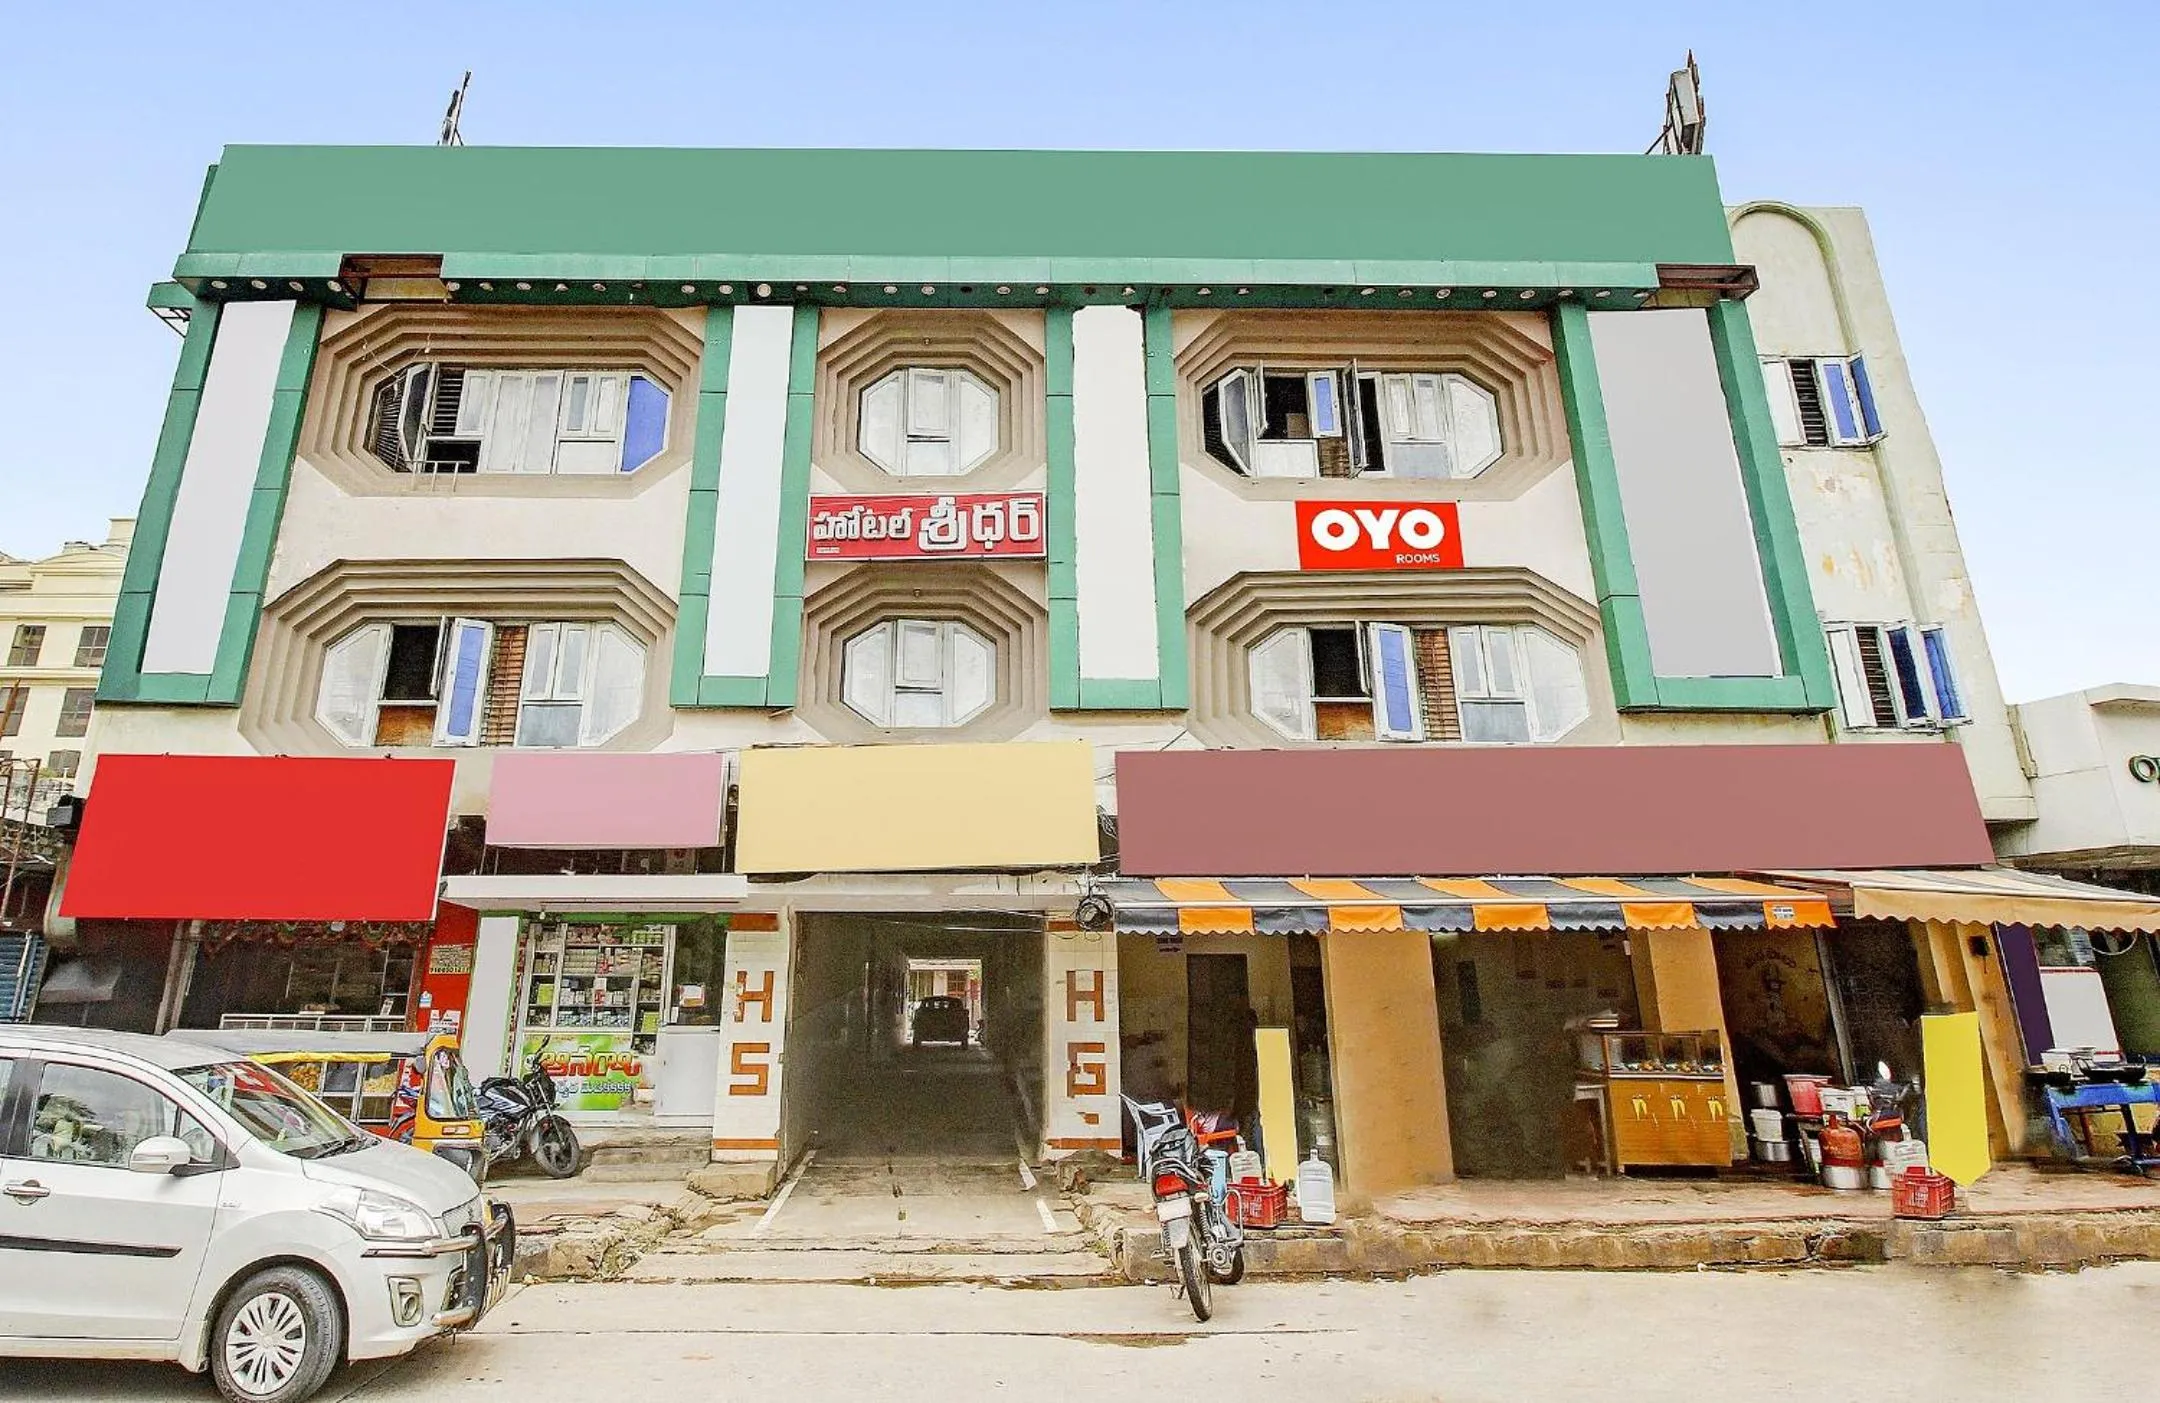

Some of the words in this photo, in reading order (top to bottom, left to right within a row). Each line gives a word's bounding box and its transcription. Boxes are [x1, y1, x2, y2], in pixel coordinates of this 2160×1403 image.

[919, 497, 1040, 552] శ్రీధర్
[1311, 508, 1445, 551] OYO
[1395, 553, 1440, 564] ROOMS
